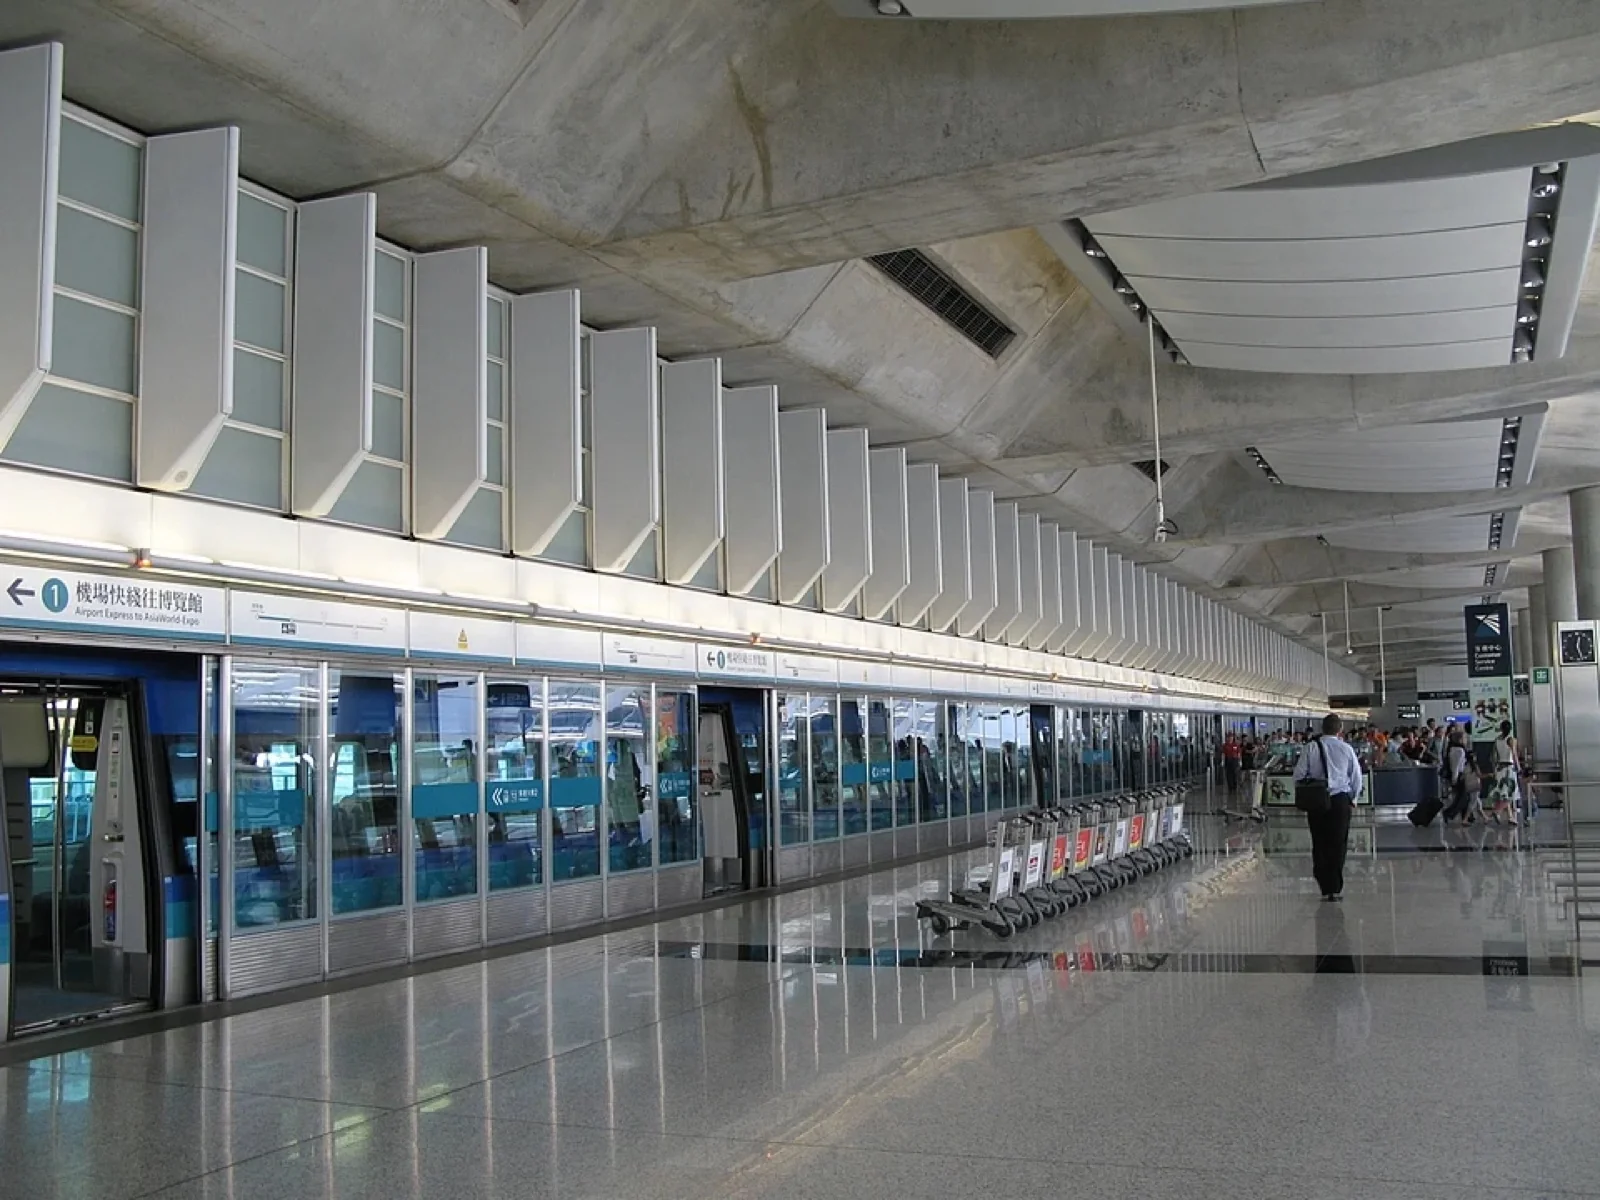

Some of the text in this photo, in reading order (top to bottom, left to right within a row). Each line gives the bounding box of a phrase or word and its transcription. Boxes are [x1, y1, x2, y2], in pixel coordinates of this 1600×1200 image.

[50, 584, 61, 608] 1
[75, 606, 103, 619] Airport
[105, 608, 134, 621] Express
[135, 612, 143, 621] to
